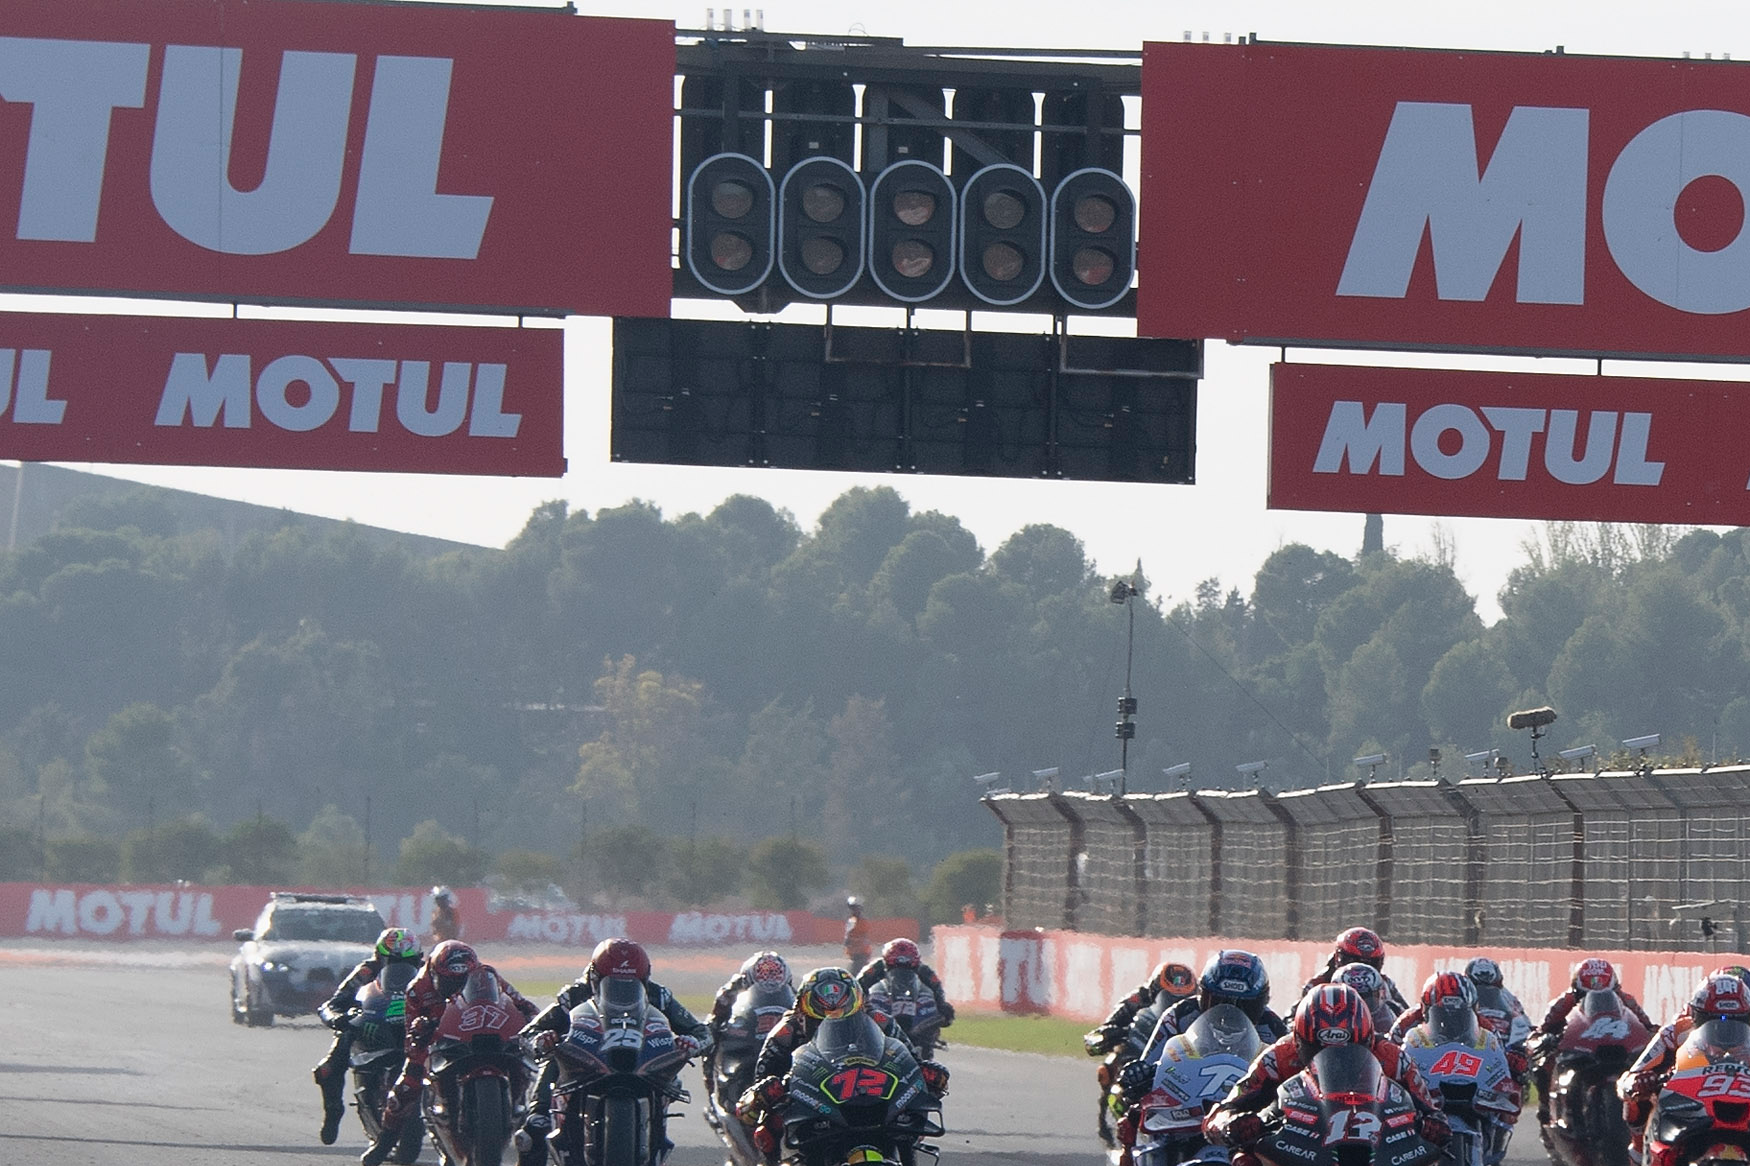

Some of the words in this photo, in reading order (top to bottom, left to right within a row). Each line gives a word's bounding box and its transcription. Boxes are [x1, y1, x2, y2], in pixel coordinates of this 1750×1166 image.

[155, 353, 522, 437] MOTUL
[1313, 401, 1664, 485] MOTUL
[27, 889, 220, 935] MOTUL
[459, 1005, 509, 1031] 37
[600, 1028, 644, 1051] 25
[1429, 1050, 1484, 1078] 49
